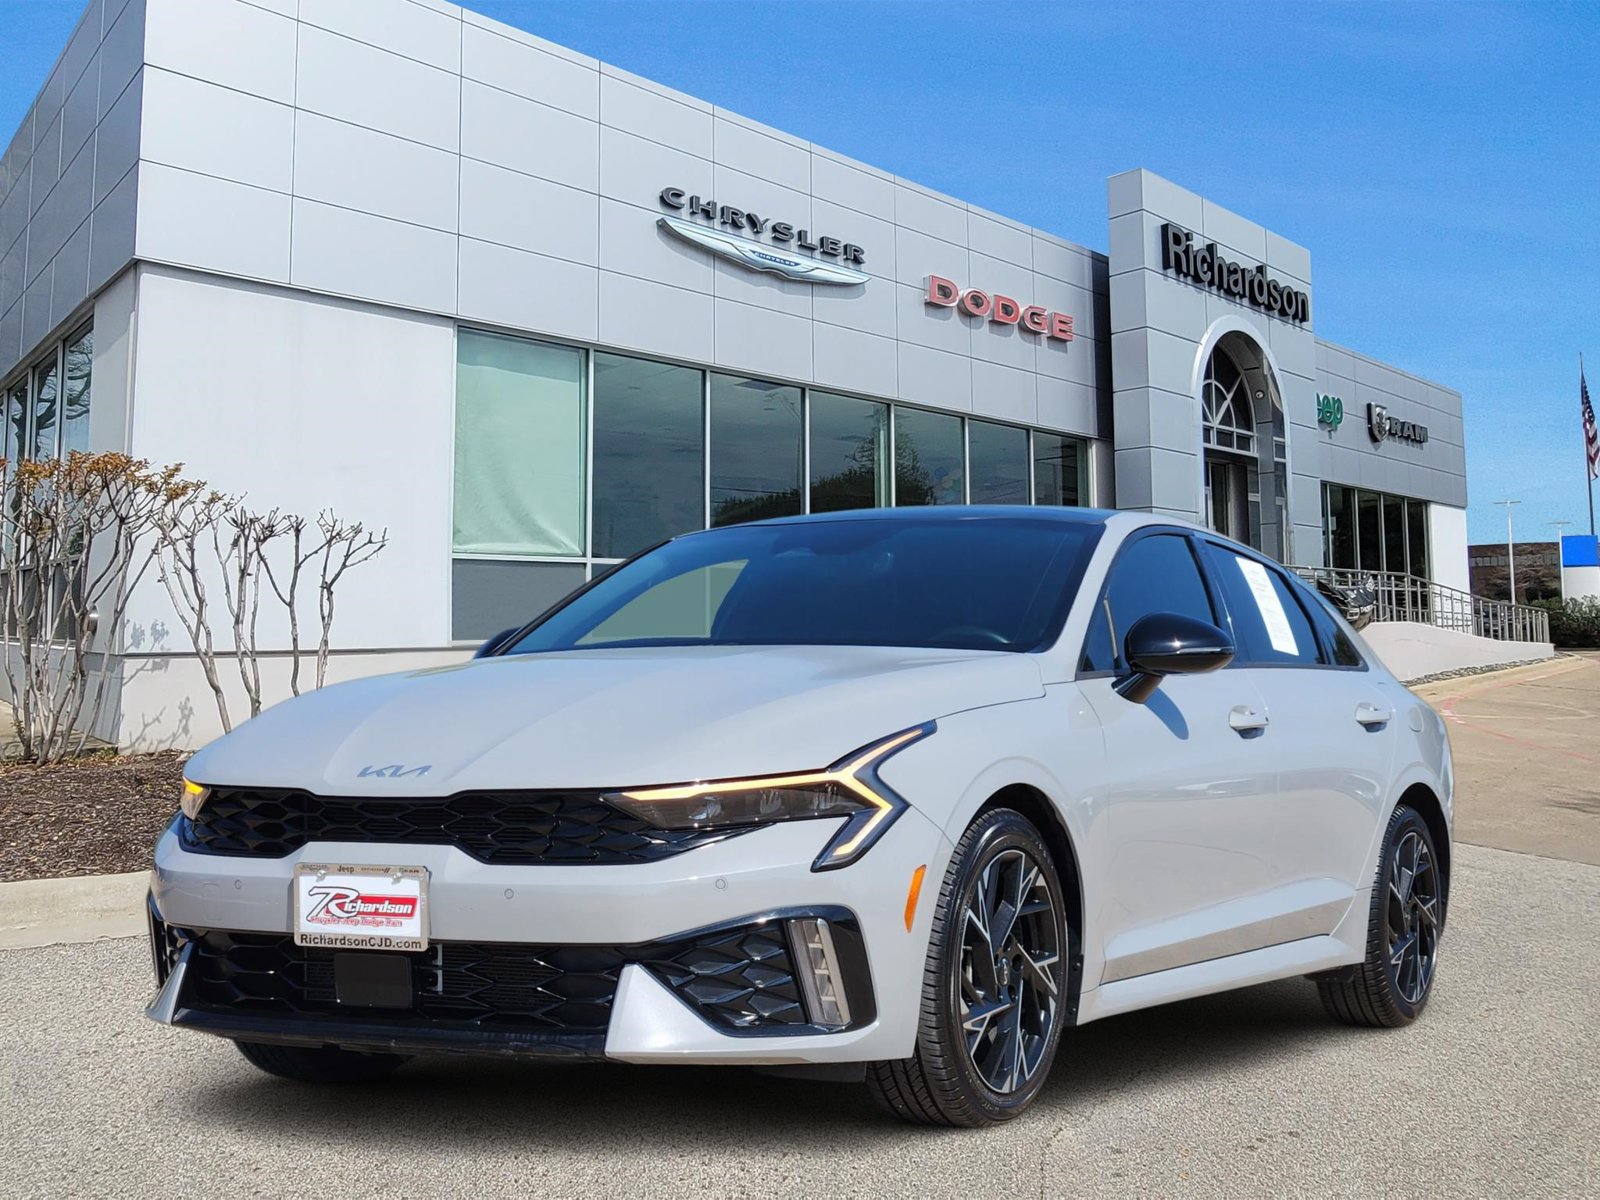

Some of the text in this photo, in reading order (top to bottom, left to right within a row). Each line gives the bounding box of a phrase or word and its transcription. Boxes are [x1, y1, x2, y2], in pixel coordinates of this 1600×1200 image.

[659, 187, 866, 264] CHRYSLER
[1161, 223, 1310, 324] Richardson
[923, 274, 1074, 342] DODGE
[1387, 416, 1429, 443] RAM
[357, 765, 432, 778] KIA
[337, 865, 355, 874] Jeep
[306, 886, 413, 922] Richardson
[300, 934, 422, 949] RichardsonCJD.com
